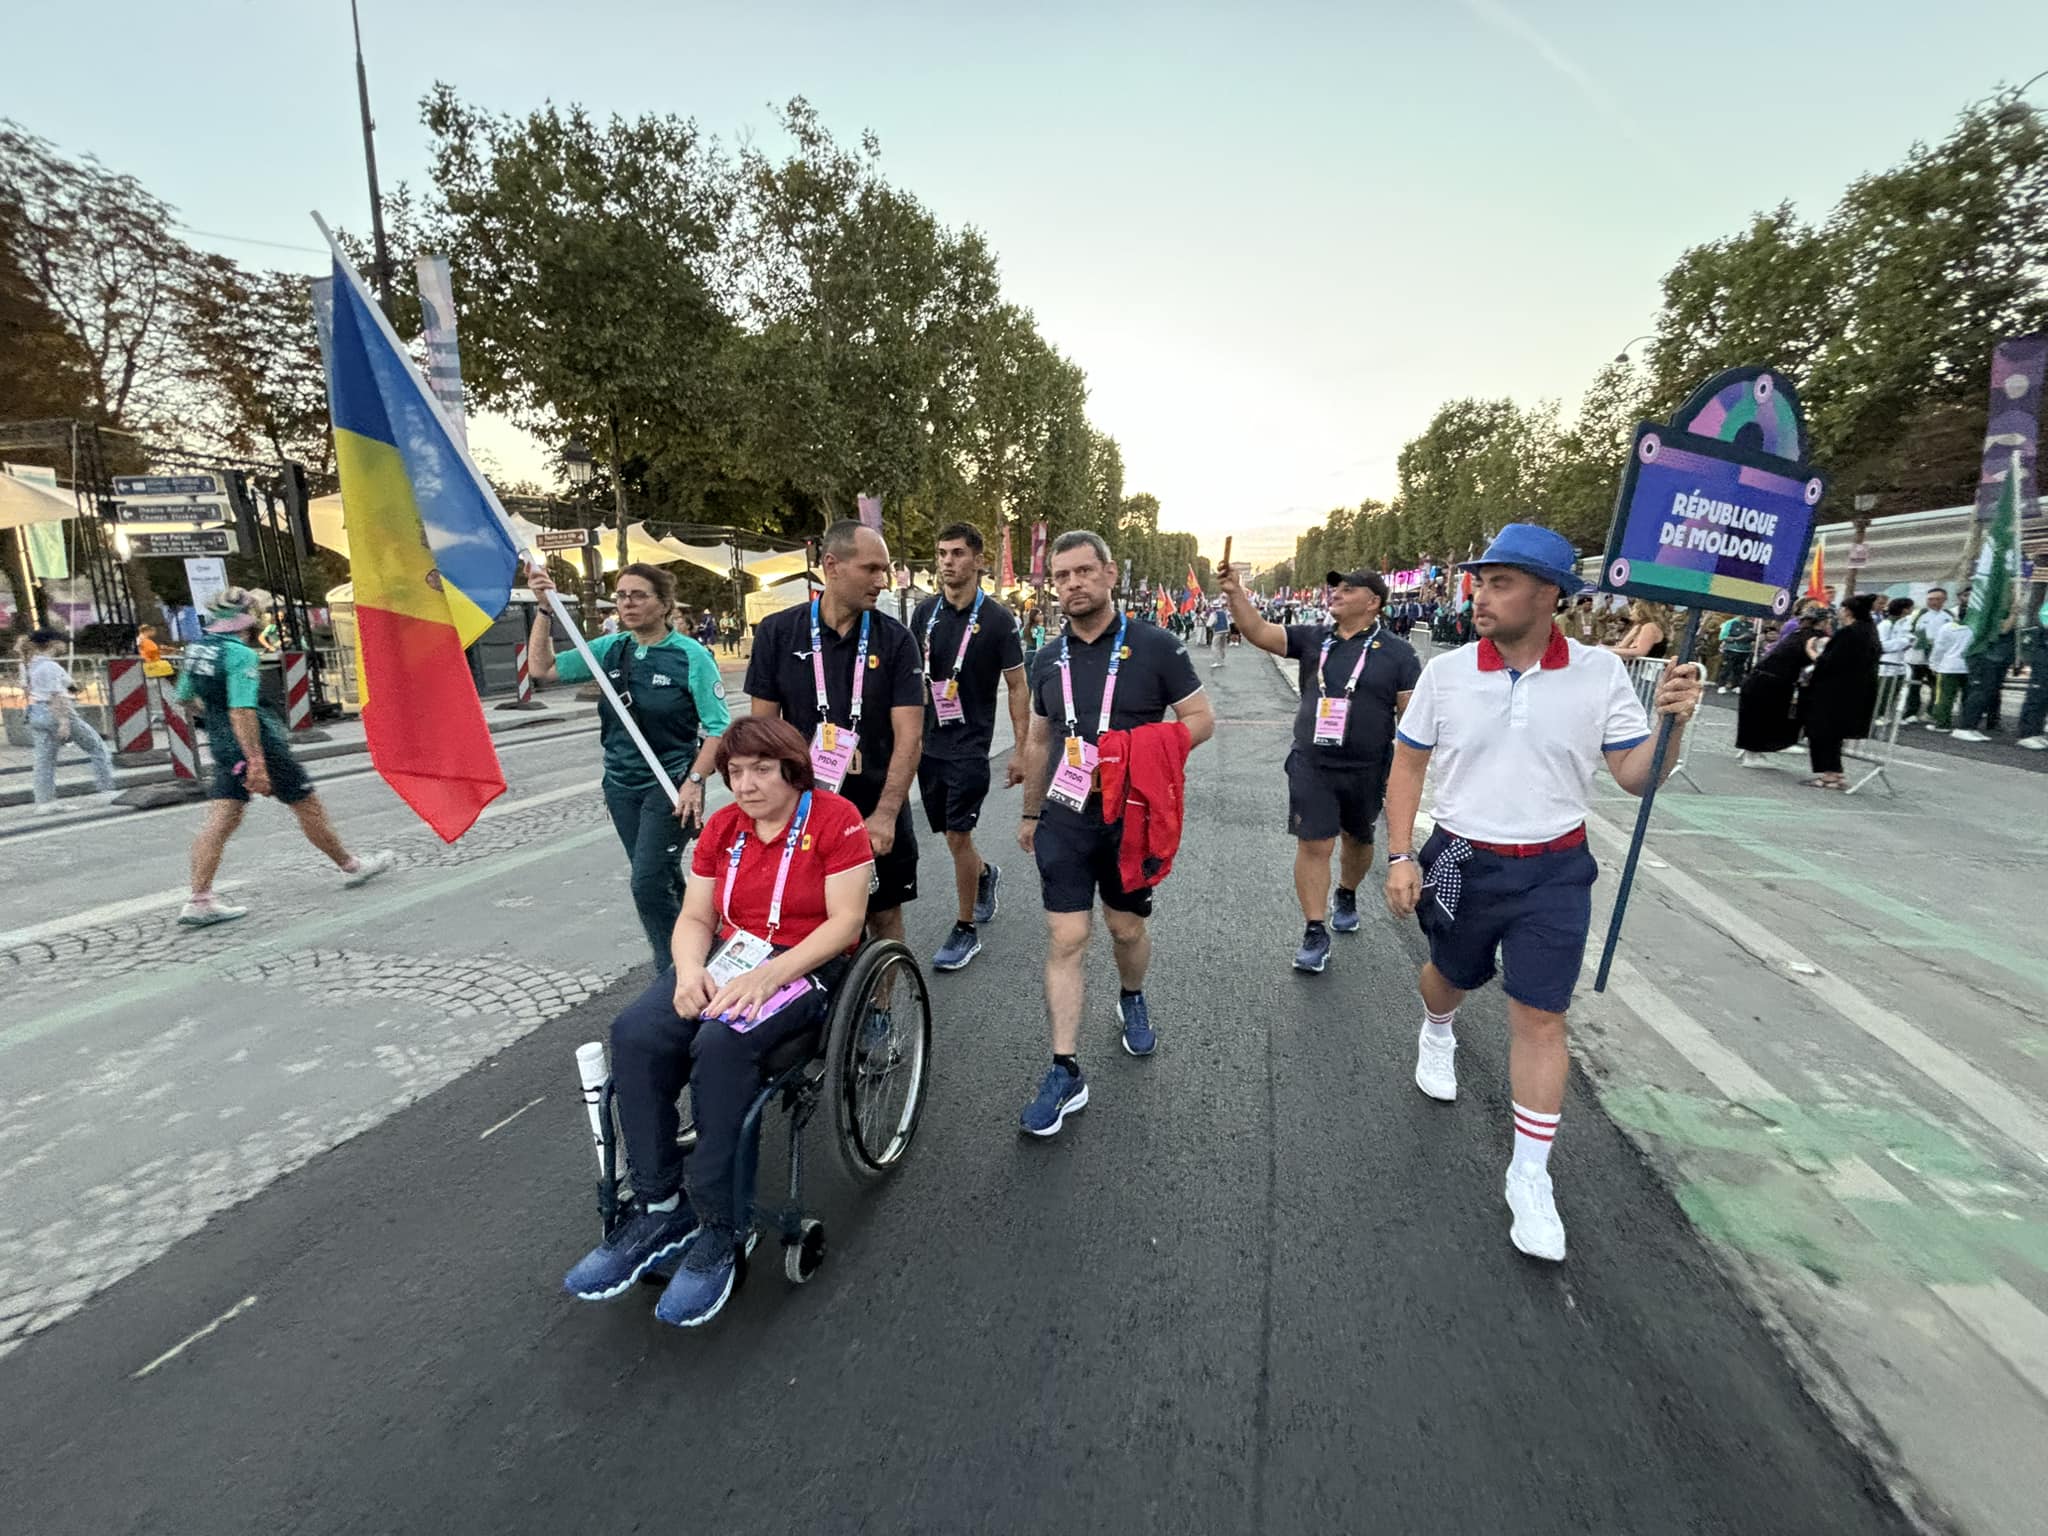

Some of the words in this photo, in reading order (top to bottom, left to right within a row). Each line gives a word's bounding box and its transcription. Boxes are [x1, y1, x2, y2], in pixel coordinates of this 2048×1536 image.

[1671, 489, 1779, 537] RÉPUBLIQUE
[1658, 521, 1688, 548] DE
[1686, 526, 1773, 566] MOLDOVA
[817, 754, 838, 767] MDA
[1064, 769, 1084, 783] MDA
